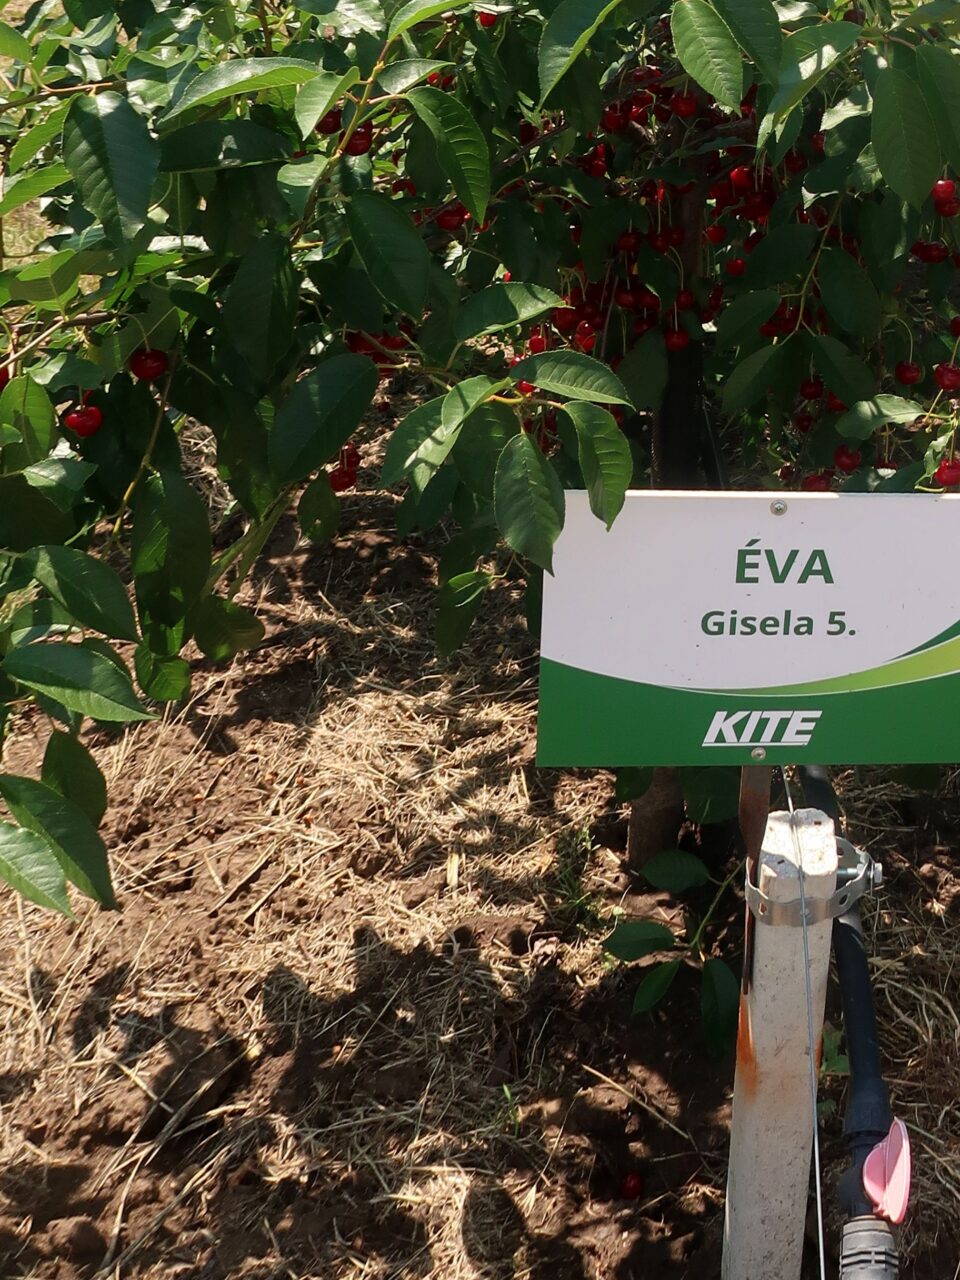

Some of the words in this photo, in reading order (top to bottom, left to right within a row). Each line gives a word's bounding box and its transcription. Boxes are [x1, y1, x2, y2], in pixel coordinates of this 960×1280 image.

[735, 538, 834, 584] ÉVA
[700, 609, 814, 636] Gisela
[826, 610, 857, 636] 5.
[701, 710, 823, 746] KITE
